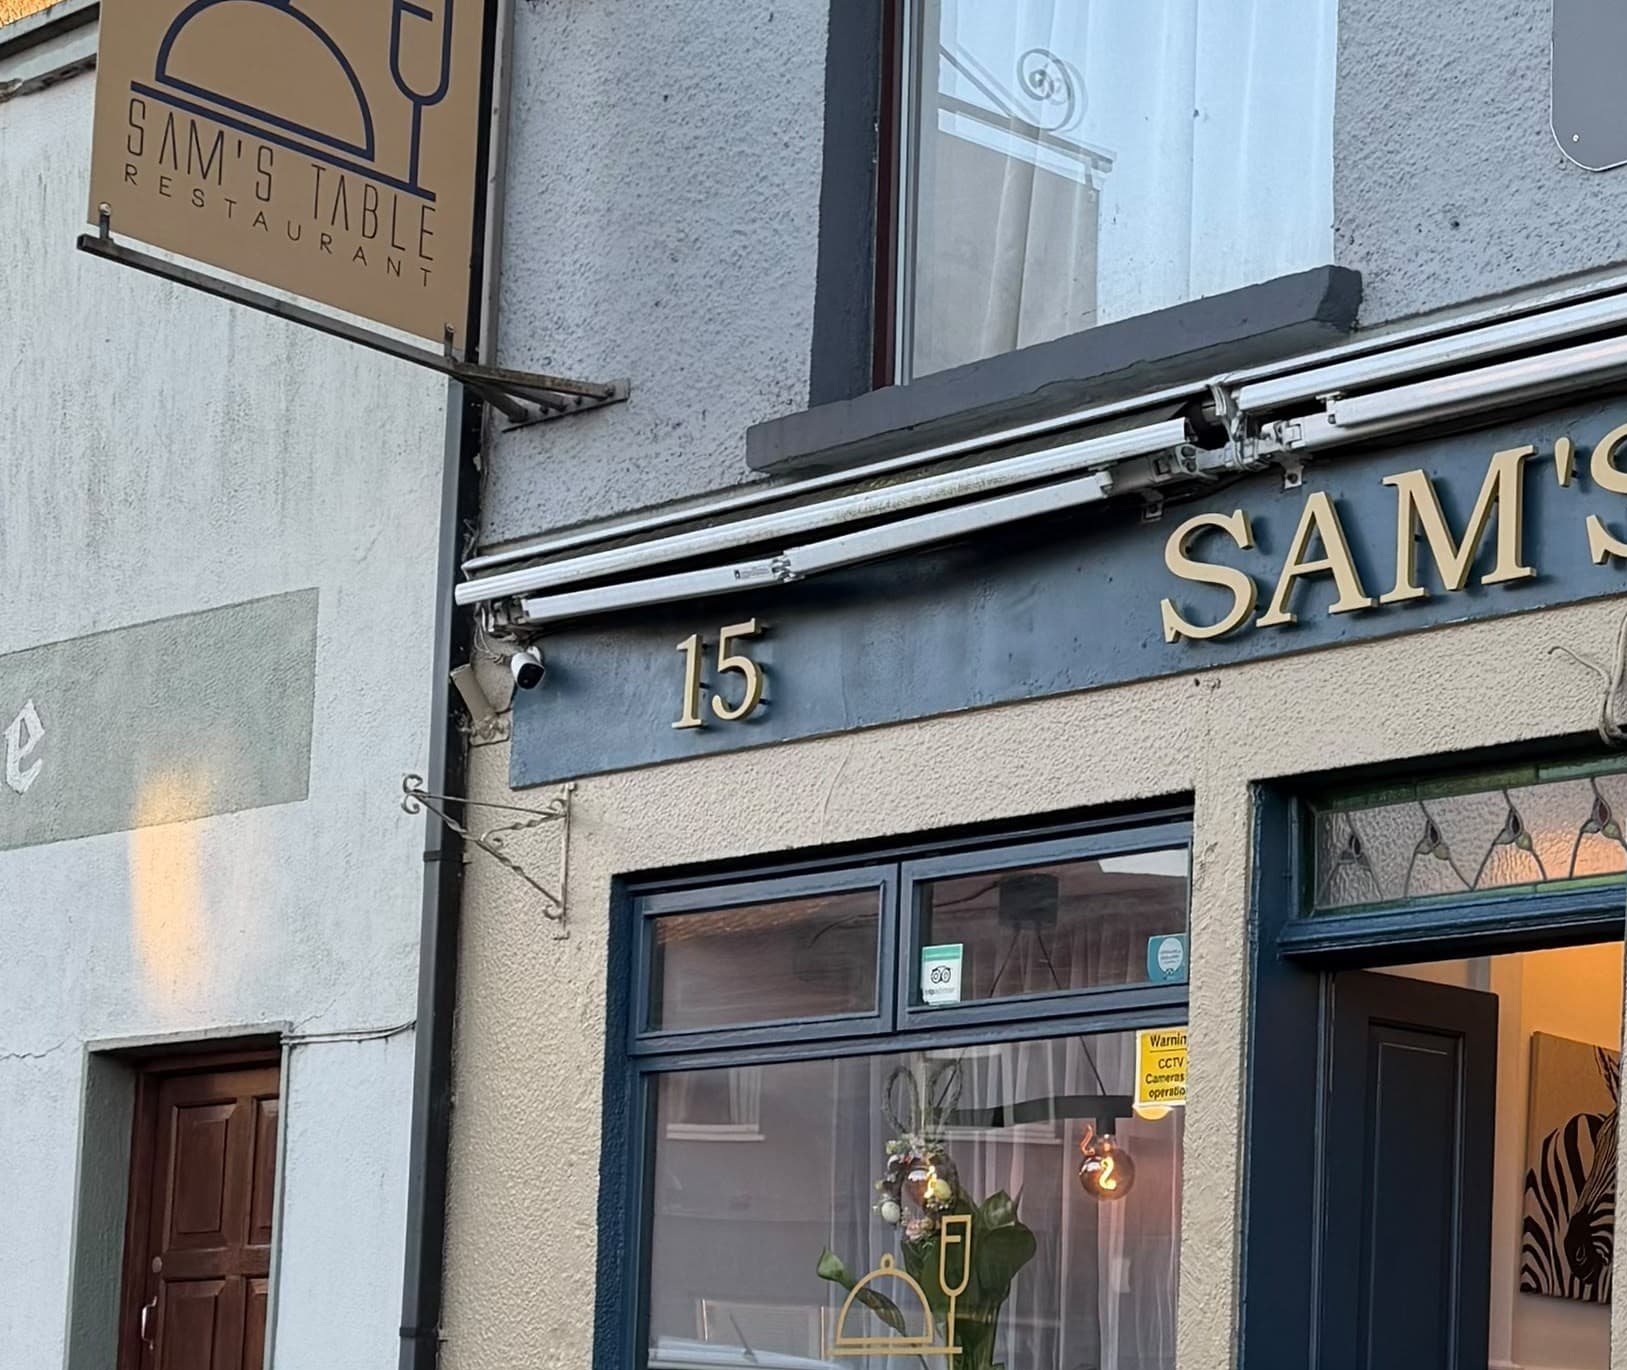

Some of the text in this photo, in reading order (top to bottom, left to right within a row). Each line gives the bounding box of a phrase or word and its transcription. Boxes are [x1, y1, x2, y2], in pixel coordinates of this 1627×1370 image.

[127, 98, 436, 261] SAM'S TABLE
[124, 163, 432, 287] RESTAURANT
[672, 618, 764, 729] 15
[1150, 1032, 1187, 1047] Warnin
[1158, 1056, 1185, 1069] CCTV
[1145, 1073, 1185, 1084] Cameras
[1148, 1086, 1186, 1100] operatio
